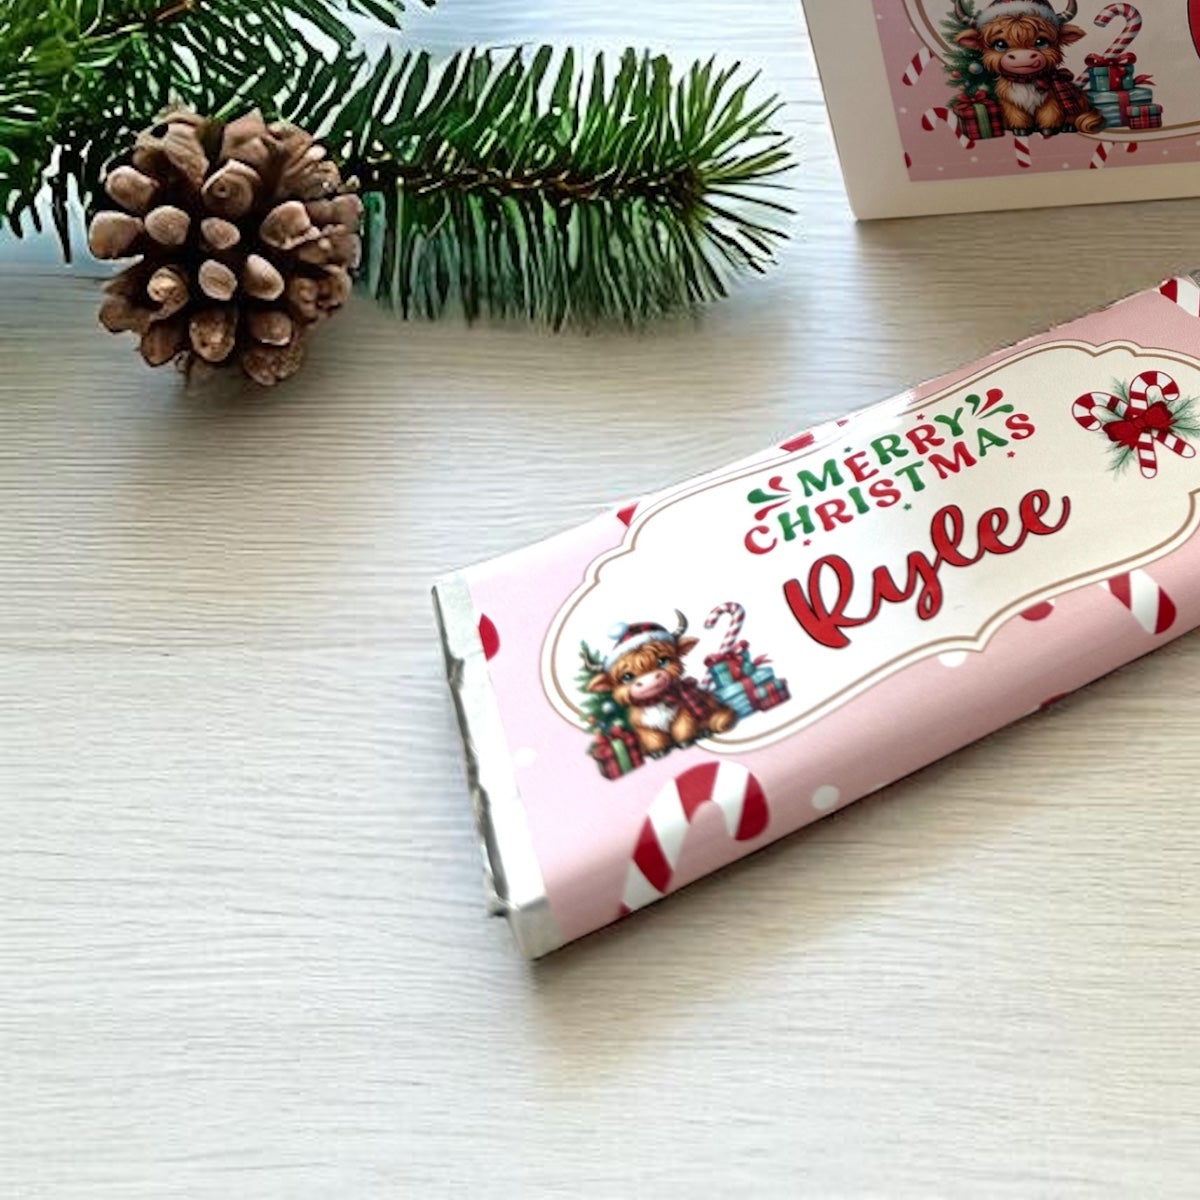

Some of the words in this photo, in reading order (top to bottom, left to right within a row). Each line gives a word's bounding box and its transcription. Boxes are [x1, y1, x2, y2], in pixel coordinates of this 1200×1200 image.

[744, 413, 1036, 555] CHRISTMAS
[797, 408, 972, 497] MERRY
[783, 489, 1071, 649] Rylee
